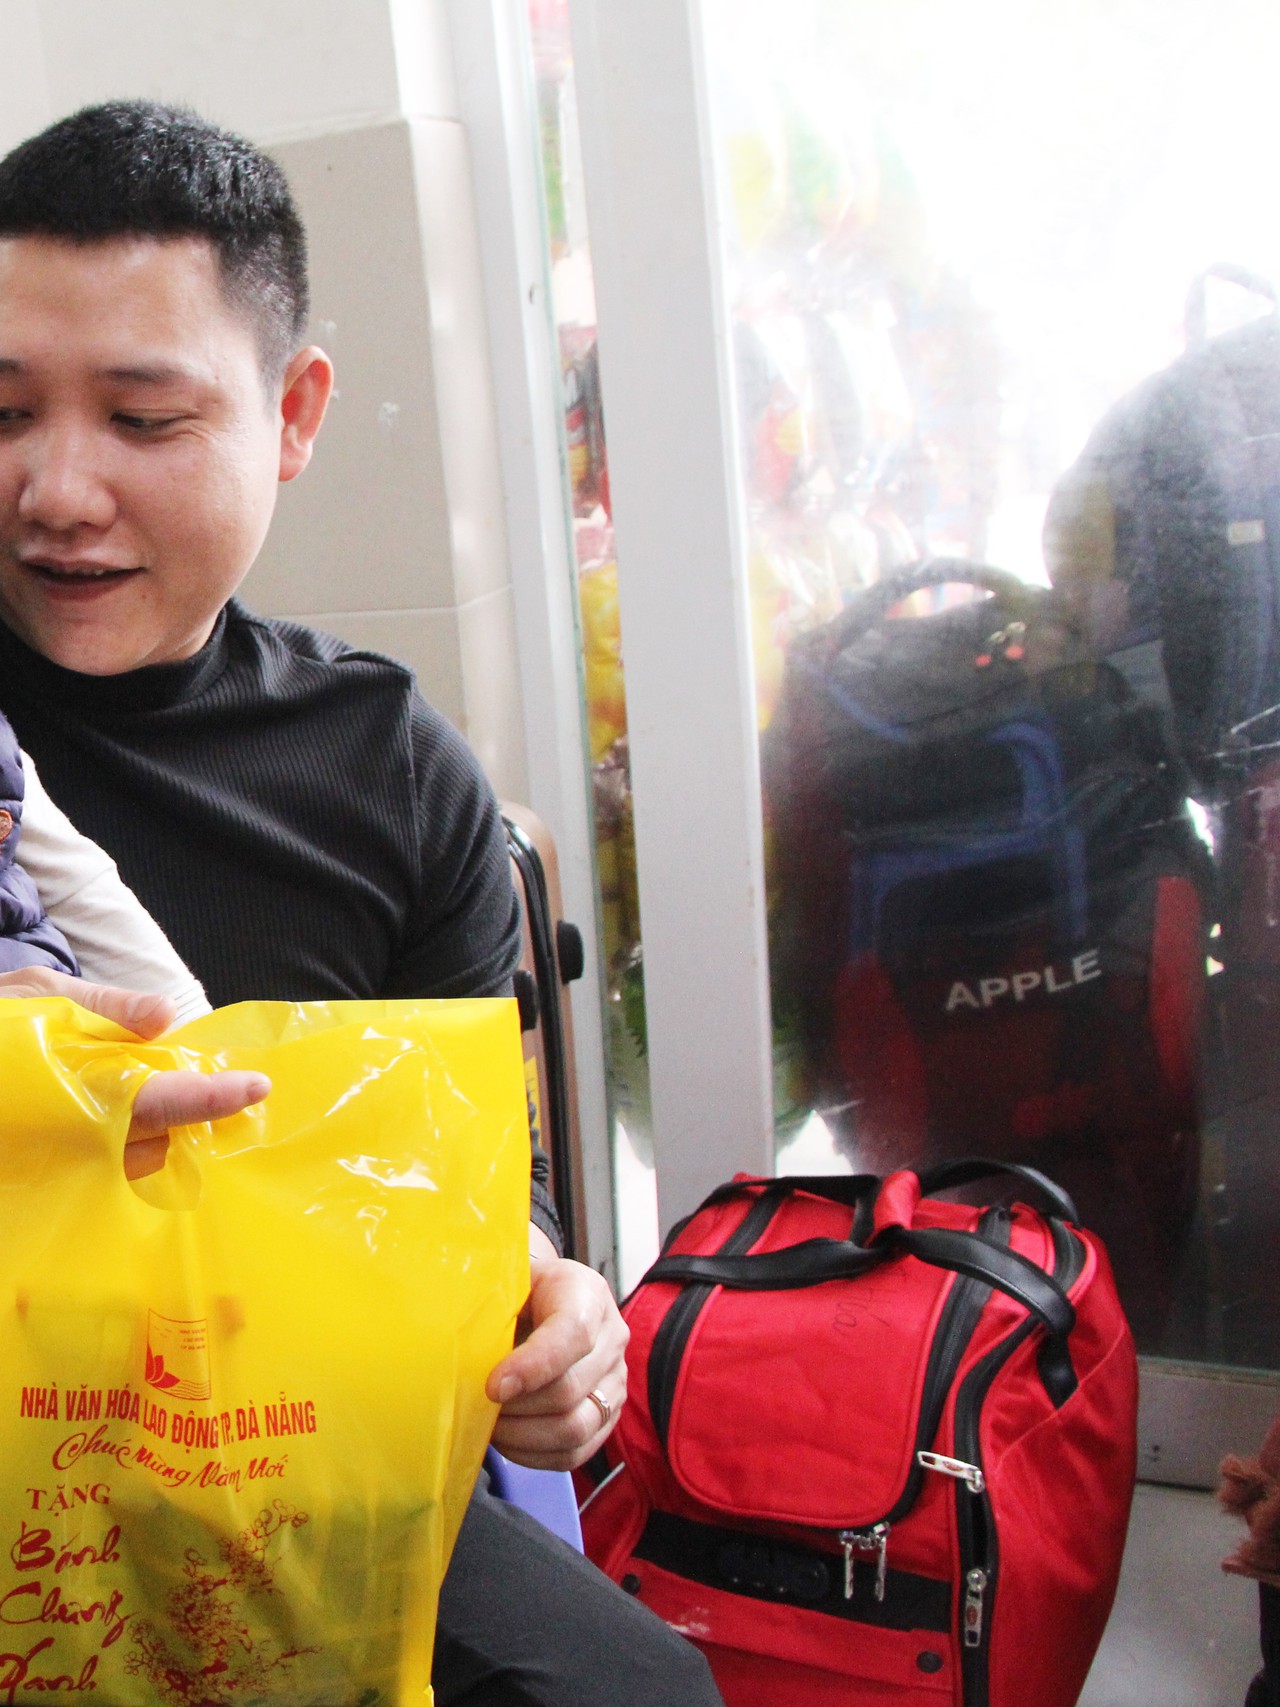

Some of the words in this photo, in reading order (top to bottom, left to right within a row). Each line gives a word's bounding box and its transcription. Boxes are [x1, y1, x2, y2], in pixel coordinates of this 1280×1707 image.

[946, 948, 1102, 1011] APPLE
[20, 1382, 58, 1420] NHÀ
[65, 1384, 102, 1421] VĂN
[105, 1384, 140, 1424] HÓA
[143, 1399, 167, 1439] LAO
[171, 1410, 219, 1453] ĐỘNG
[236, 1400, 260, 1441] ĐÀ
[264, 1391, 317, 1438] NẴNG
[52, 1424, 133, 1470] Chúc
[188, 1460, 240, 1493] Năm
[246, 1454, 288, 1481] Mới
[25, 1482, 111, 1517] TẶNG
[11, 1521, 121, 1574] Bánh
